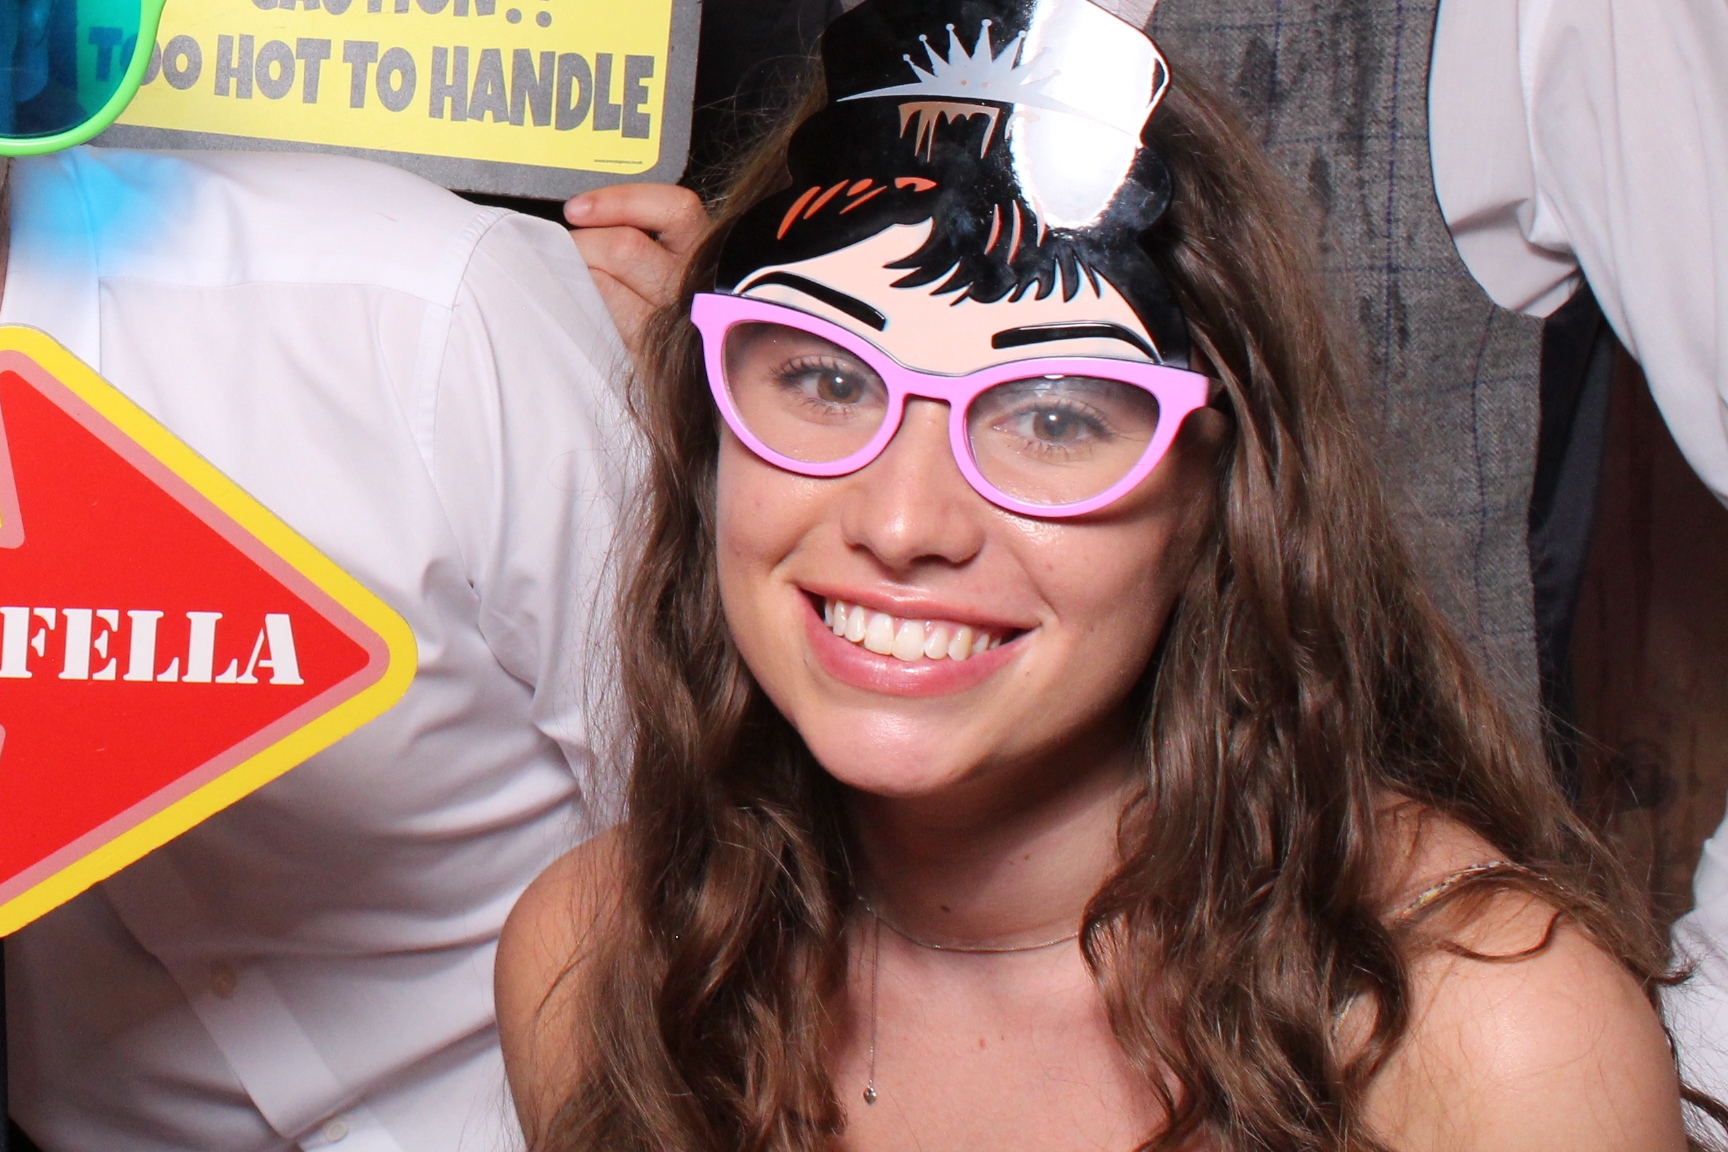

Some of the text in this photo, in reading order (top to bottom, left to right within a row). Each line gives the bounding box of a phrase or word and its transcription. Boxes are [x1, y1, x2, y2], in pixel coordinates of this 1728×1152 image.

[213, 33, 332, 104] HOT
[341, 39, 417, 113] TO
[428, 47, 656, 140] HANDLE
